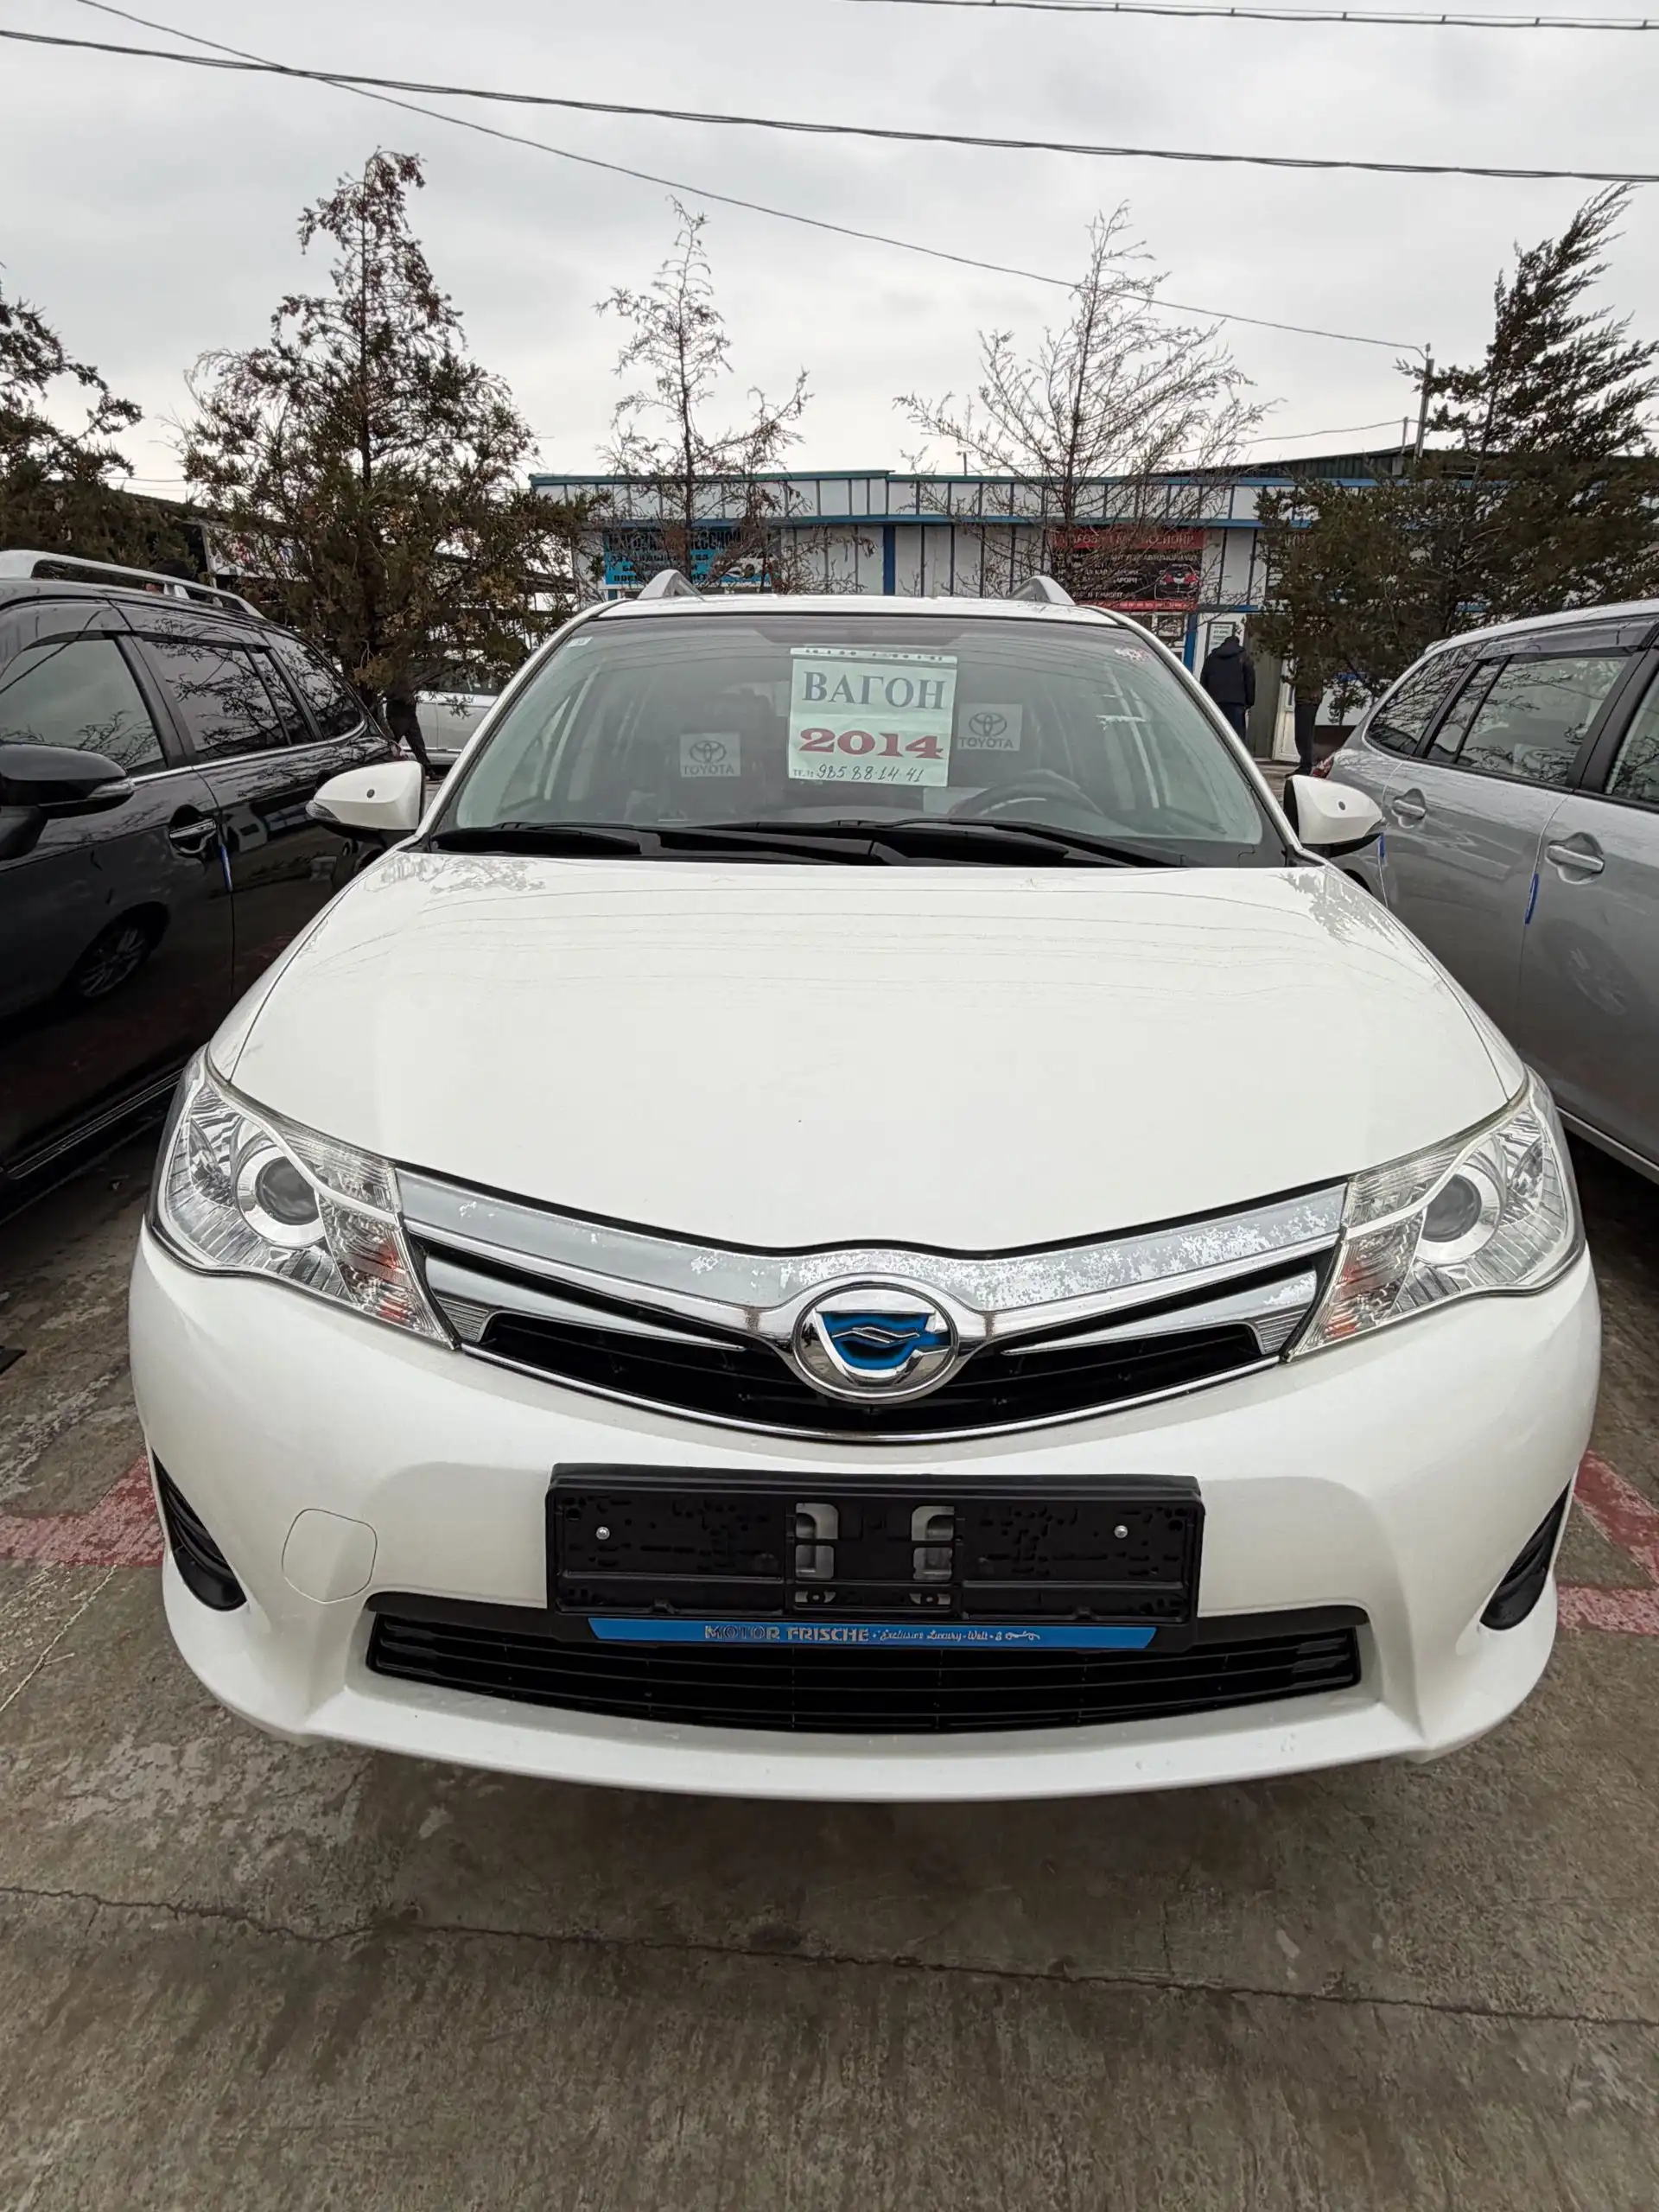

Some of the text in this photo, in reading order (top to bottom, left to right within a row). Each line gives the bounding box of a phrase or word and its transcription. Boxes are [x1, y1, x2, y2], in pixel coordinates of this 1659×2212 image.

[802, 671, 946, 709] ВАГОН
[798, 728, 944, 760] 2014
[958, 736, 1014, 749] TOYOTA
[683, 764, 734, 776] TOYOTA
[704, 1624, 780, 1639] MOTOR
[787, 1627, 869, 1642] FRISCHE
